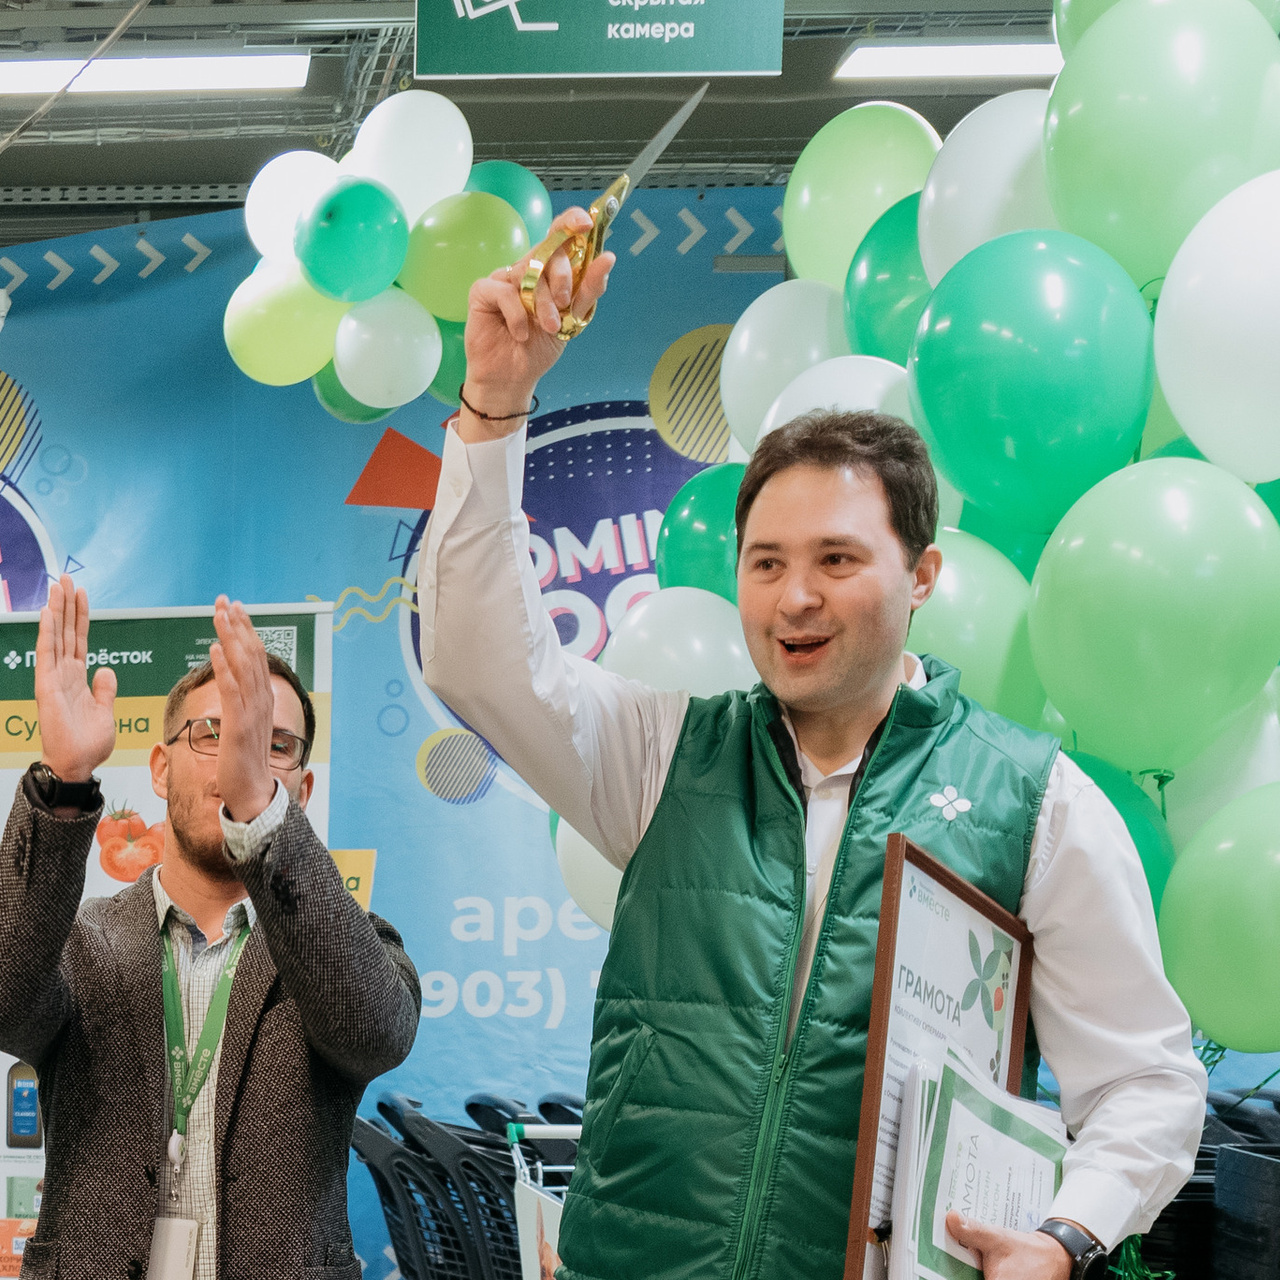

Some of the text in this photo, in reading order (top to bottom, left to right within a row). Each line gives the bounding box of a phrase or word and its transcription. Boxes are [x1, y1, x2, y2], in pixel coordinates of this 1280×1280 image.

[607, 22, 694, 43] камера
[897, 964, 962, 1027] ГРАМОТА
[961, 1134, 979, 1218] АМОТА
